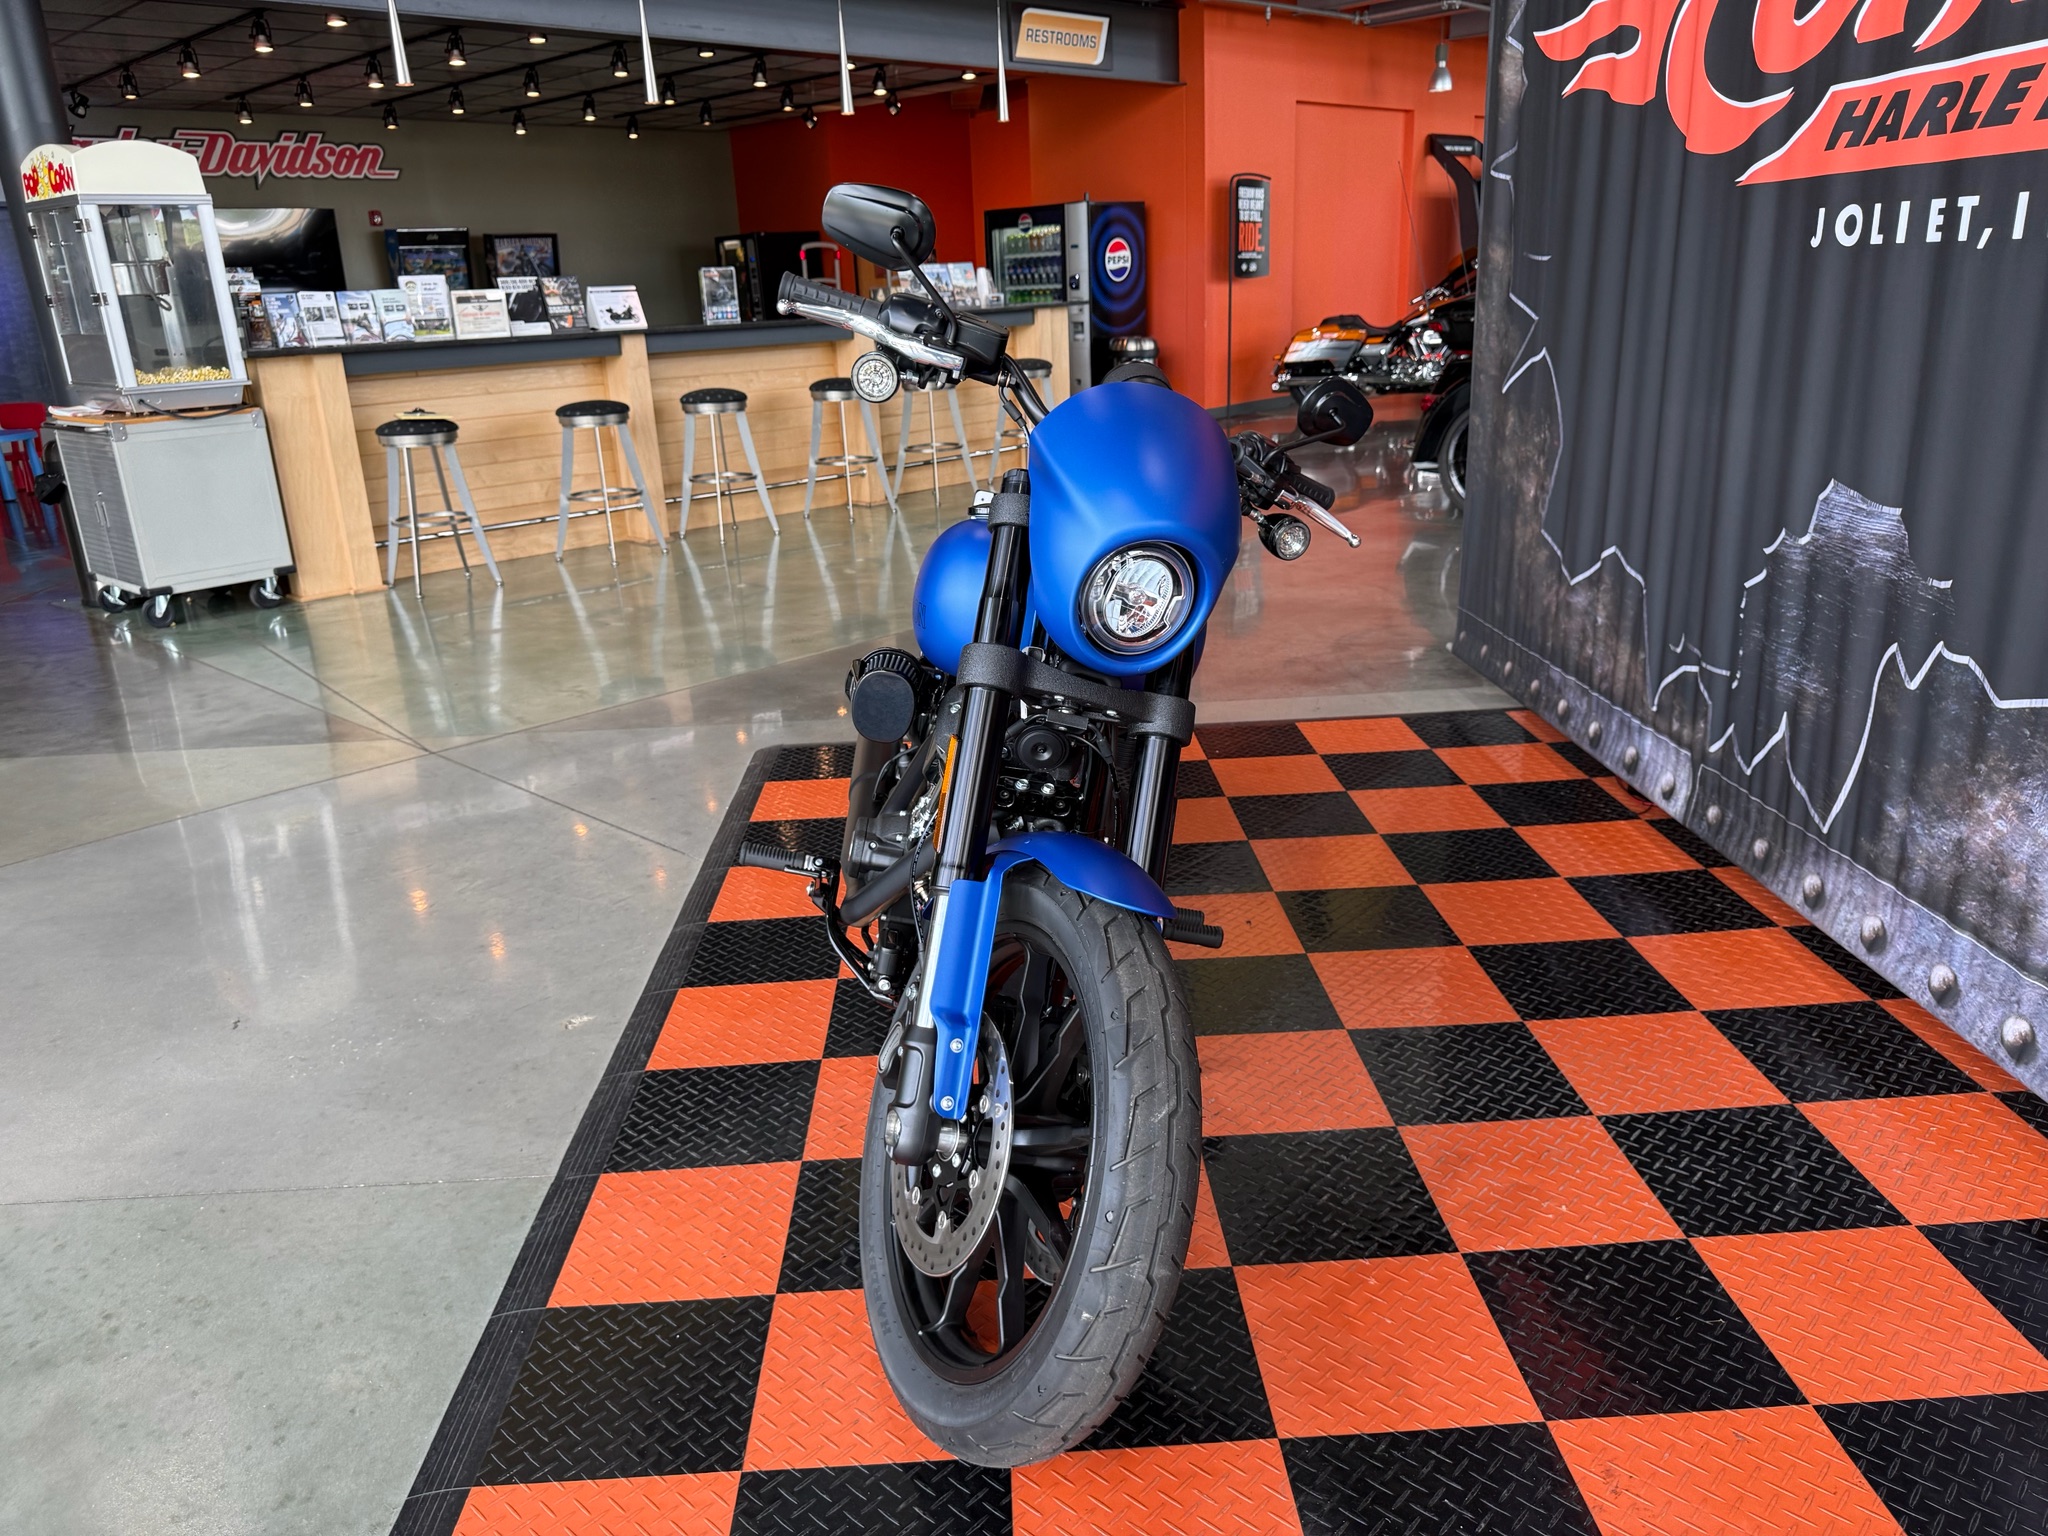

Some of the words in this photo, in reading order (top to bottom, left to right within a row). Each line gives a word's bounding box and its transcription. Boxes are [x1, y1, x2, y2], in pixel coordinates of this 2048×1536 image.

[1025, 28, 1098, 49] RESTROOMS
[22, 165, 40, 201] POP
[47, 161, 76, 194] CORN
[1810, 195, 1993, 249] JOLIET,
[2011, 191, 2048, 240] I
[1238, 222, 1265, 252] RIDE.
[1107, 255, 1130, 265] PEPSI
